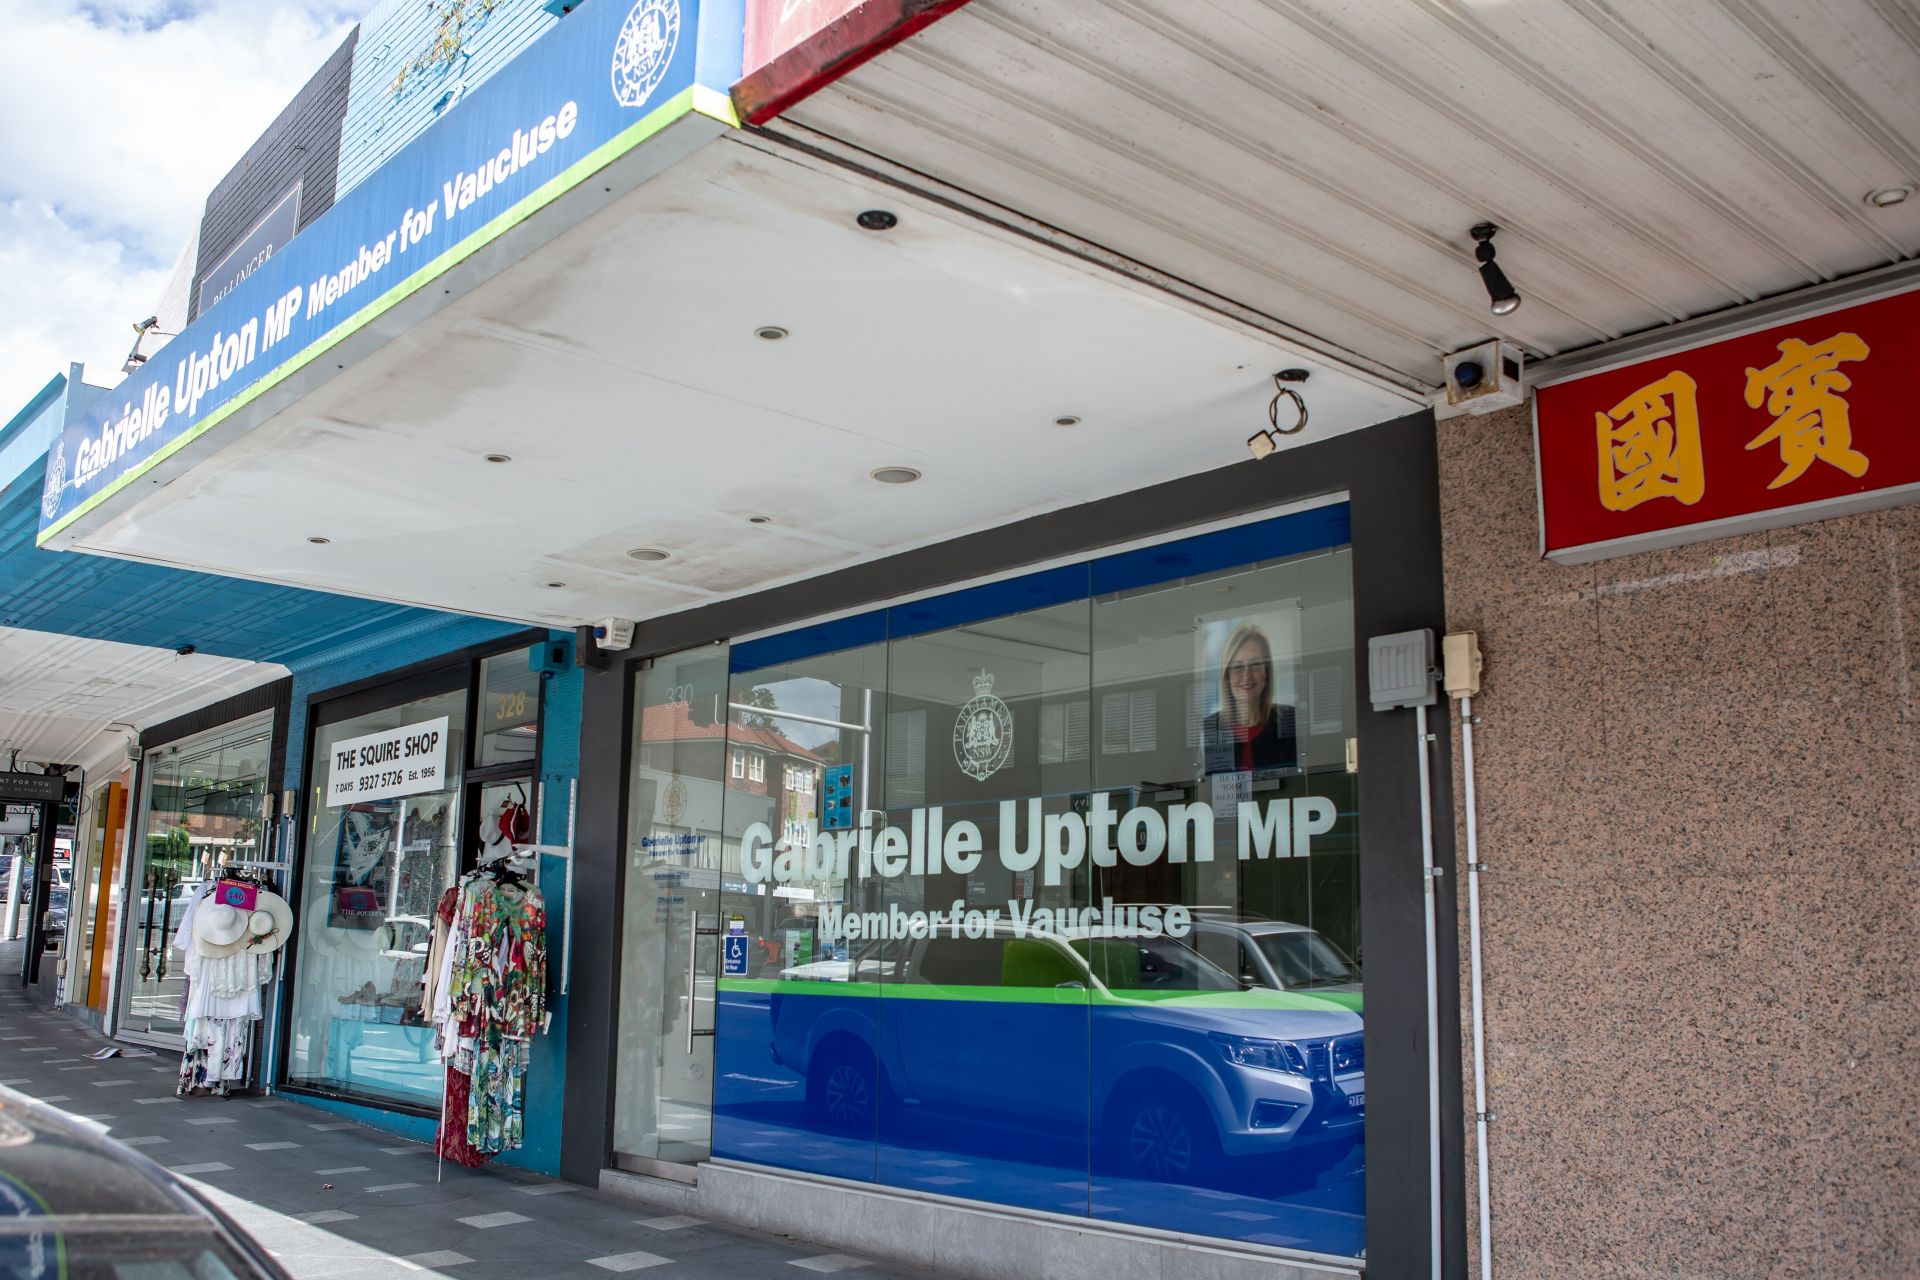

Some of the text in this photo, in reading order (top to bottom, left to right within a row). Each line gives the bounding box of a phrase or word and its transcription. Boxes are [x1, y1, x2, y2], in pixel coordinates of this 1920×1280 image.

[633, 52, 658, 81] NSW
[74, 100, 578, 488] Gabrielle Upton MP Member for Vaucluse
[496, 689, 526, 720] 328
[664, 683, 694, 710] 330
[337, 731, 439, 771] THE SQUIRE SHOP
[972, 747, 993, 758] NSW
[335, 766, 435, 793] 7 DAYS 9327 5726 Est. 1956
[740, 792, 1337, 886] Gabrielle Upton MP
[818, 896, 1192, 940] Member for Vaucluse
